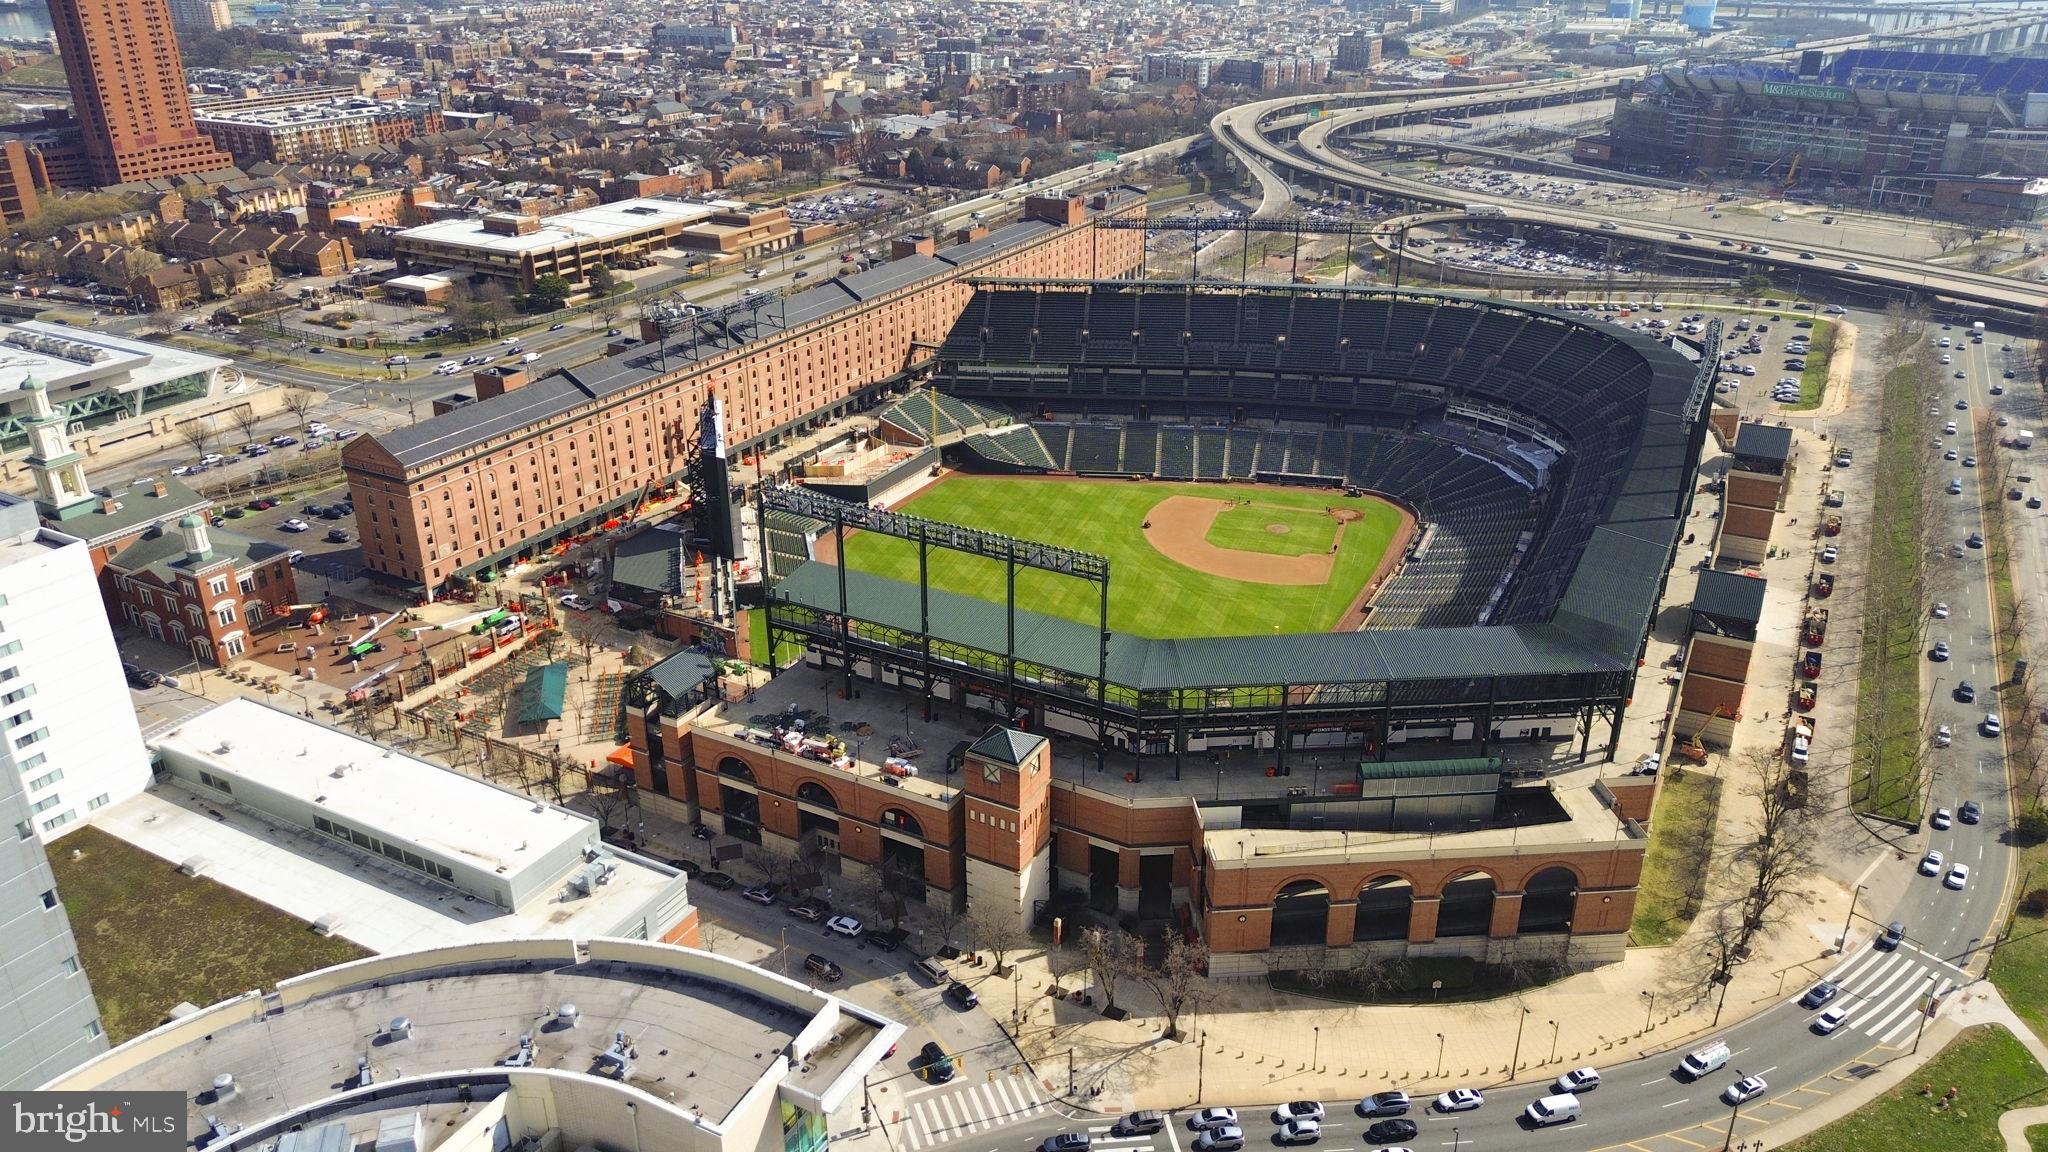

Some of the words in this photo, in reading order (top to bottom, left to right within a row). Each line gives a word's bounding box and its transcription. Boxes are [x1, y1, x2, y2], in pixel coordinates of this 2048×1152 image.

[1763, 83, 1786, 95] M&T
[1786, 85, 1807, 97] Bank
[1808, 87, 1845, 100] Stadium
